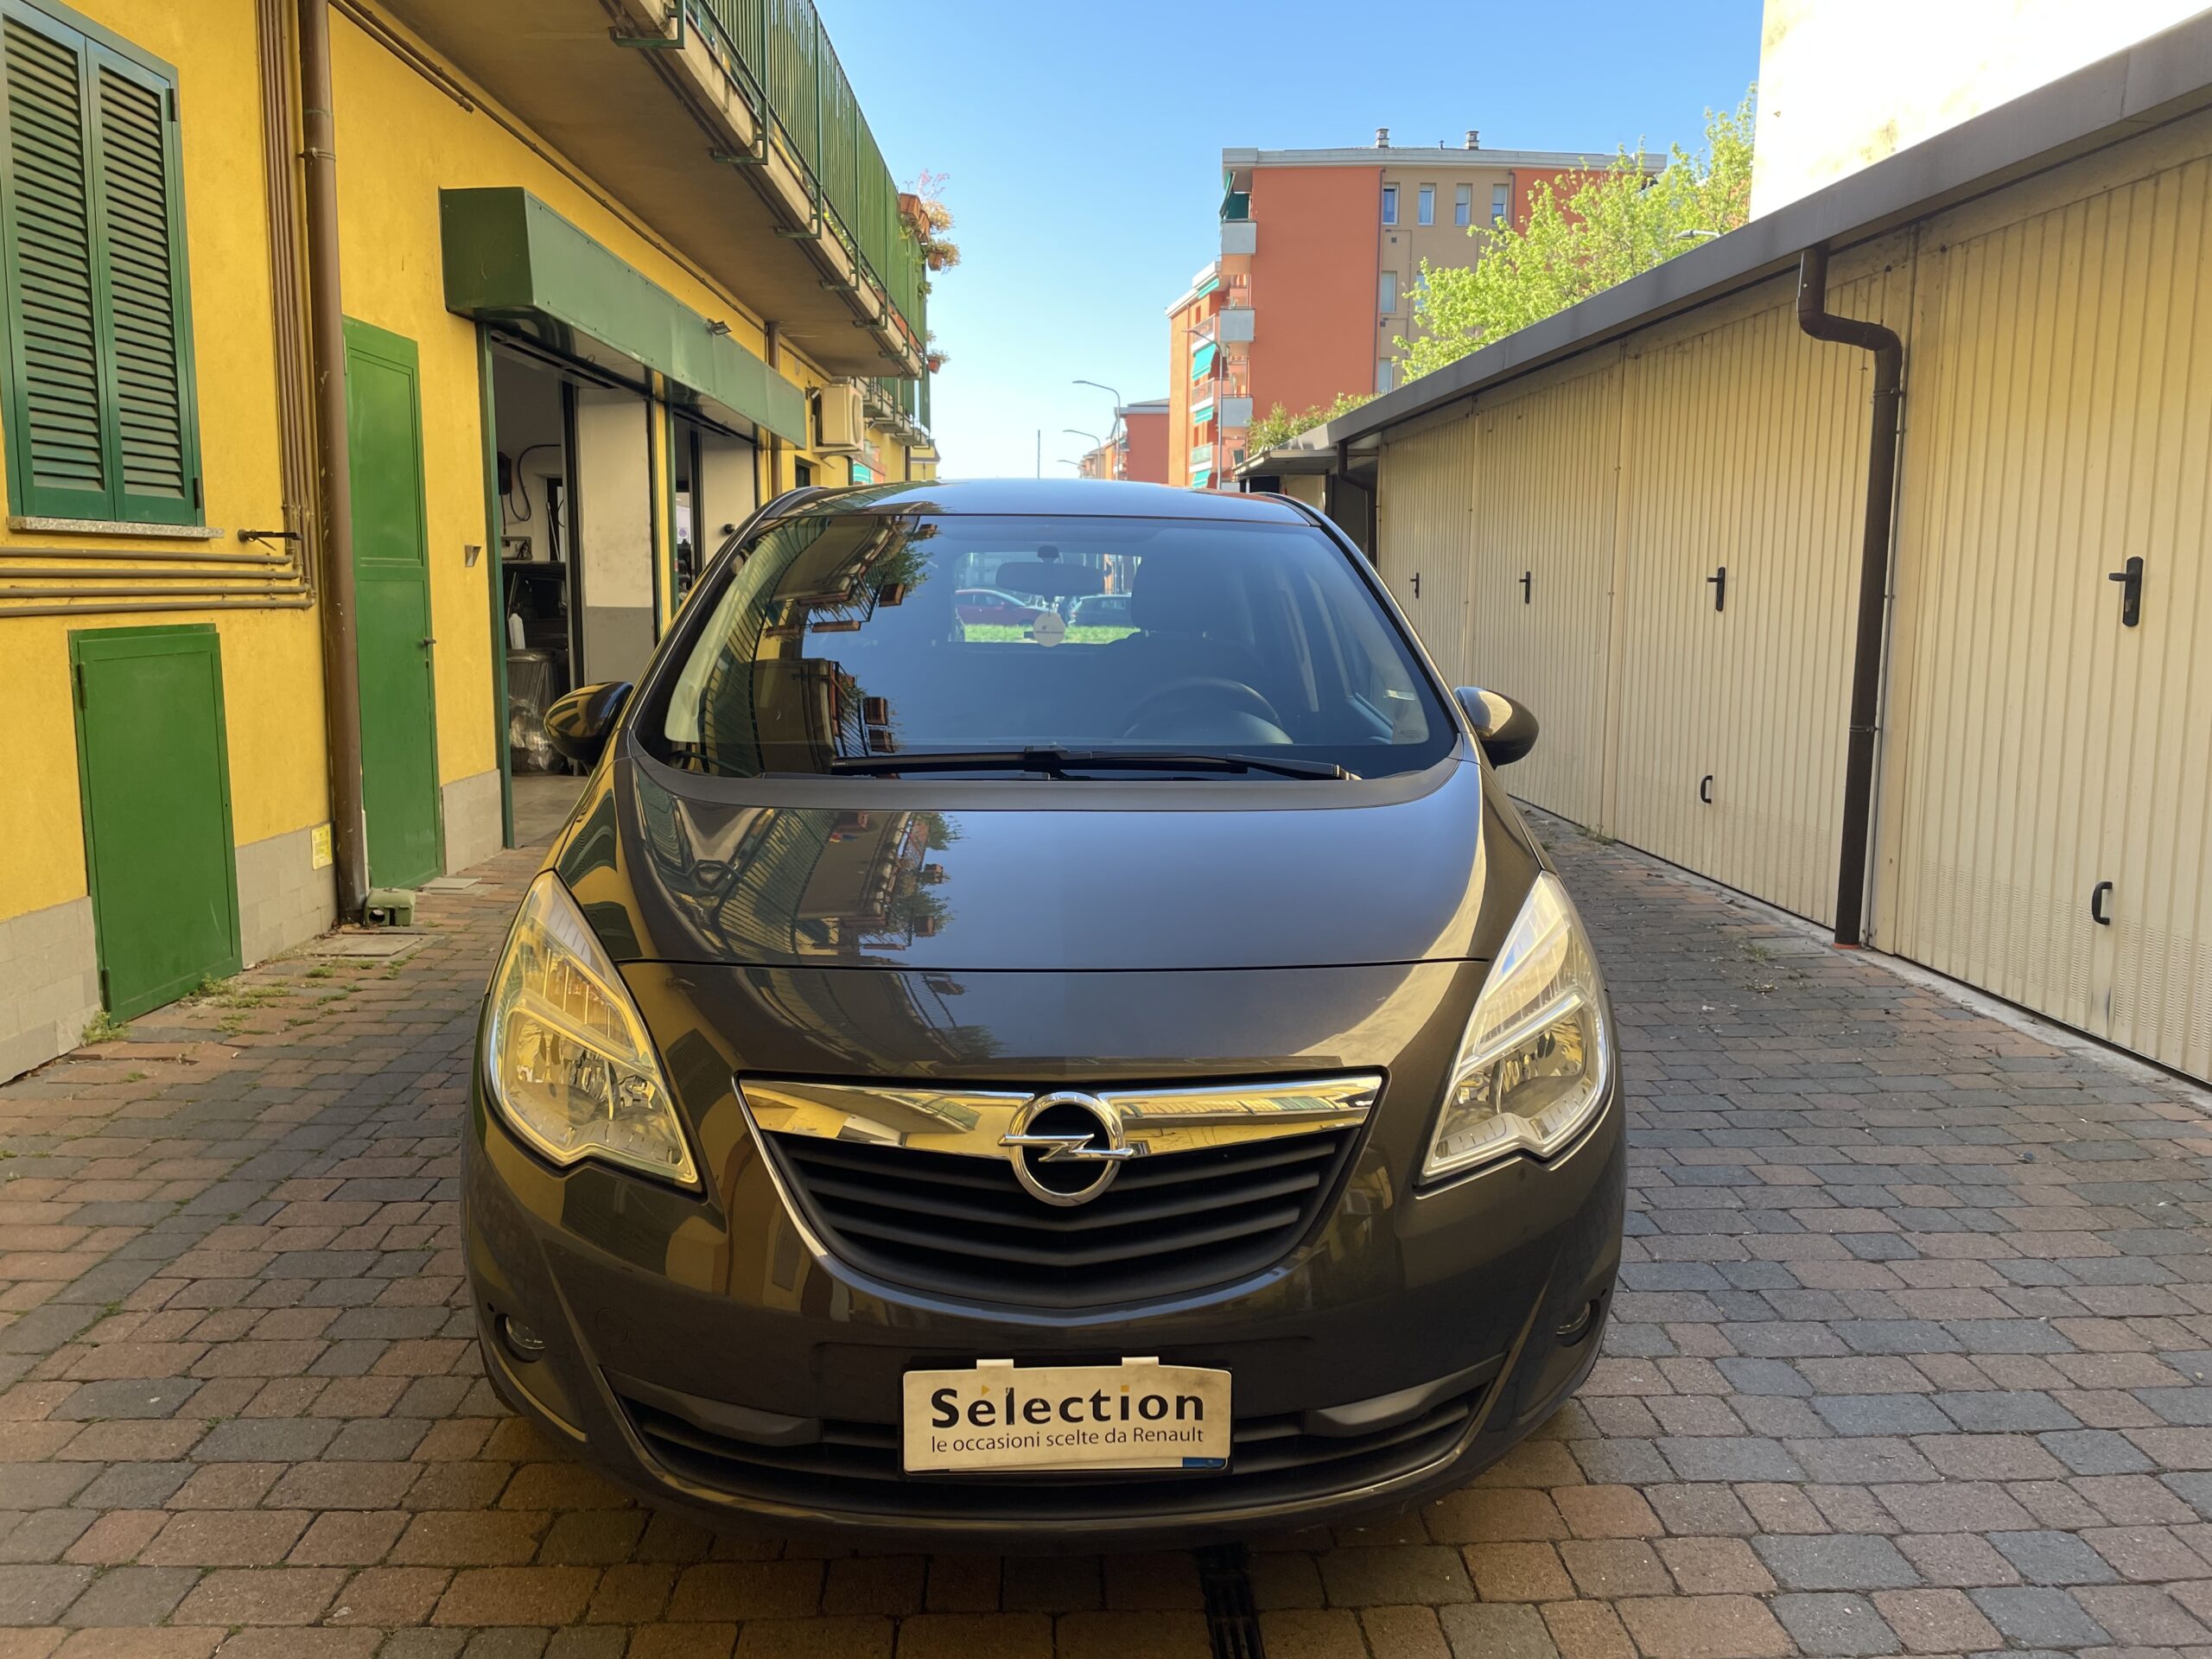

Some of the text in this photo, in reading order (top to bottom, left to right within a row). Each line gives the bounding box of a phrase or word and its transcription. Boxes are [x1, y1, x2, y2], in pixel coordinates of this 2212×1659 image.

[931, 1426, 1204, 1452] le occasioni scelte da Renault
